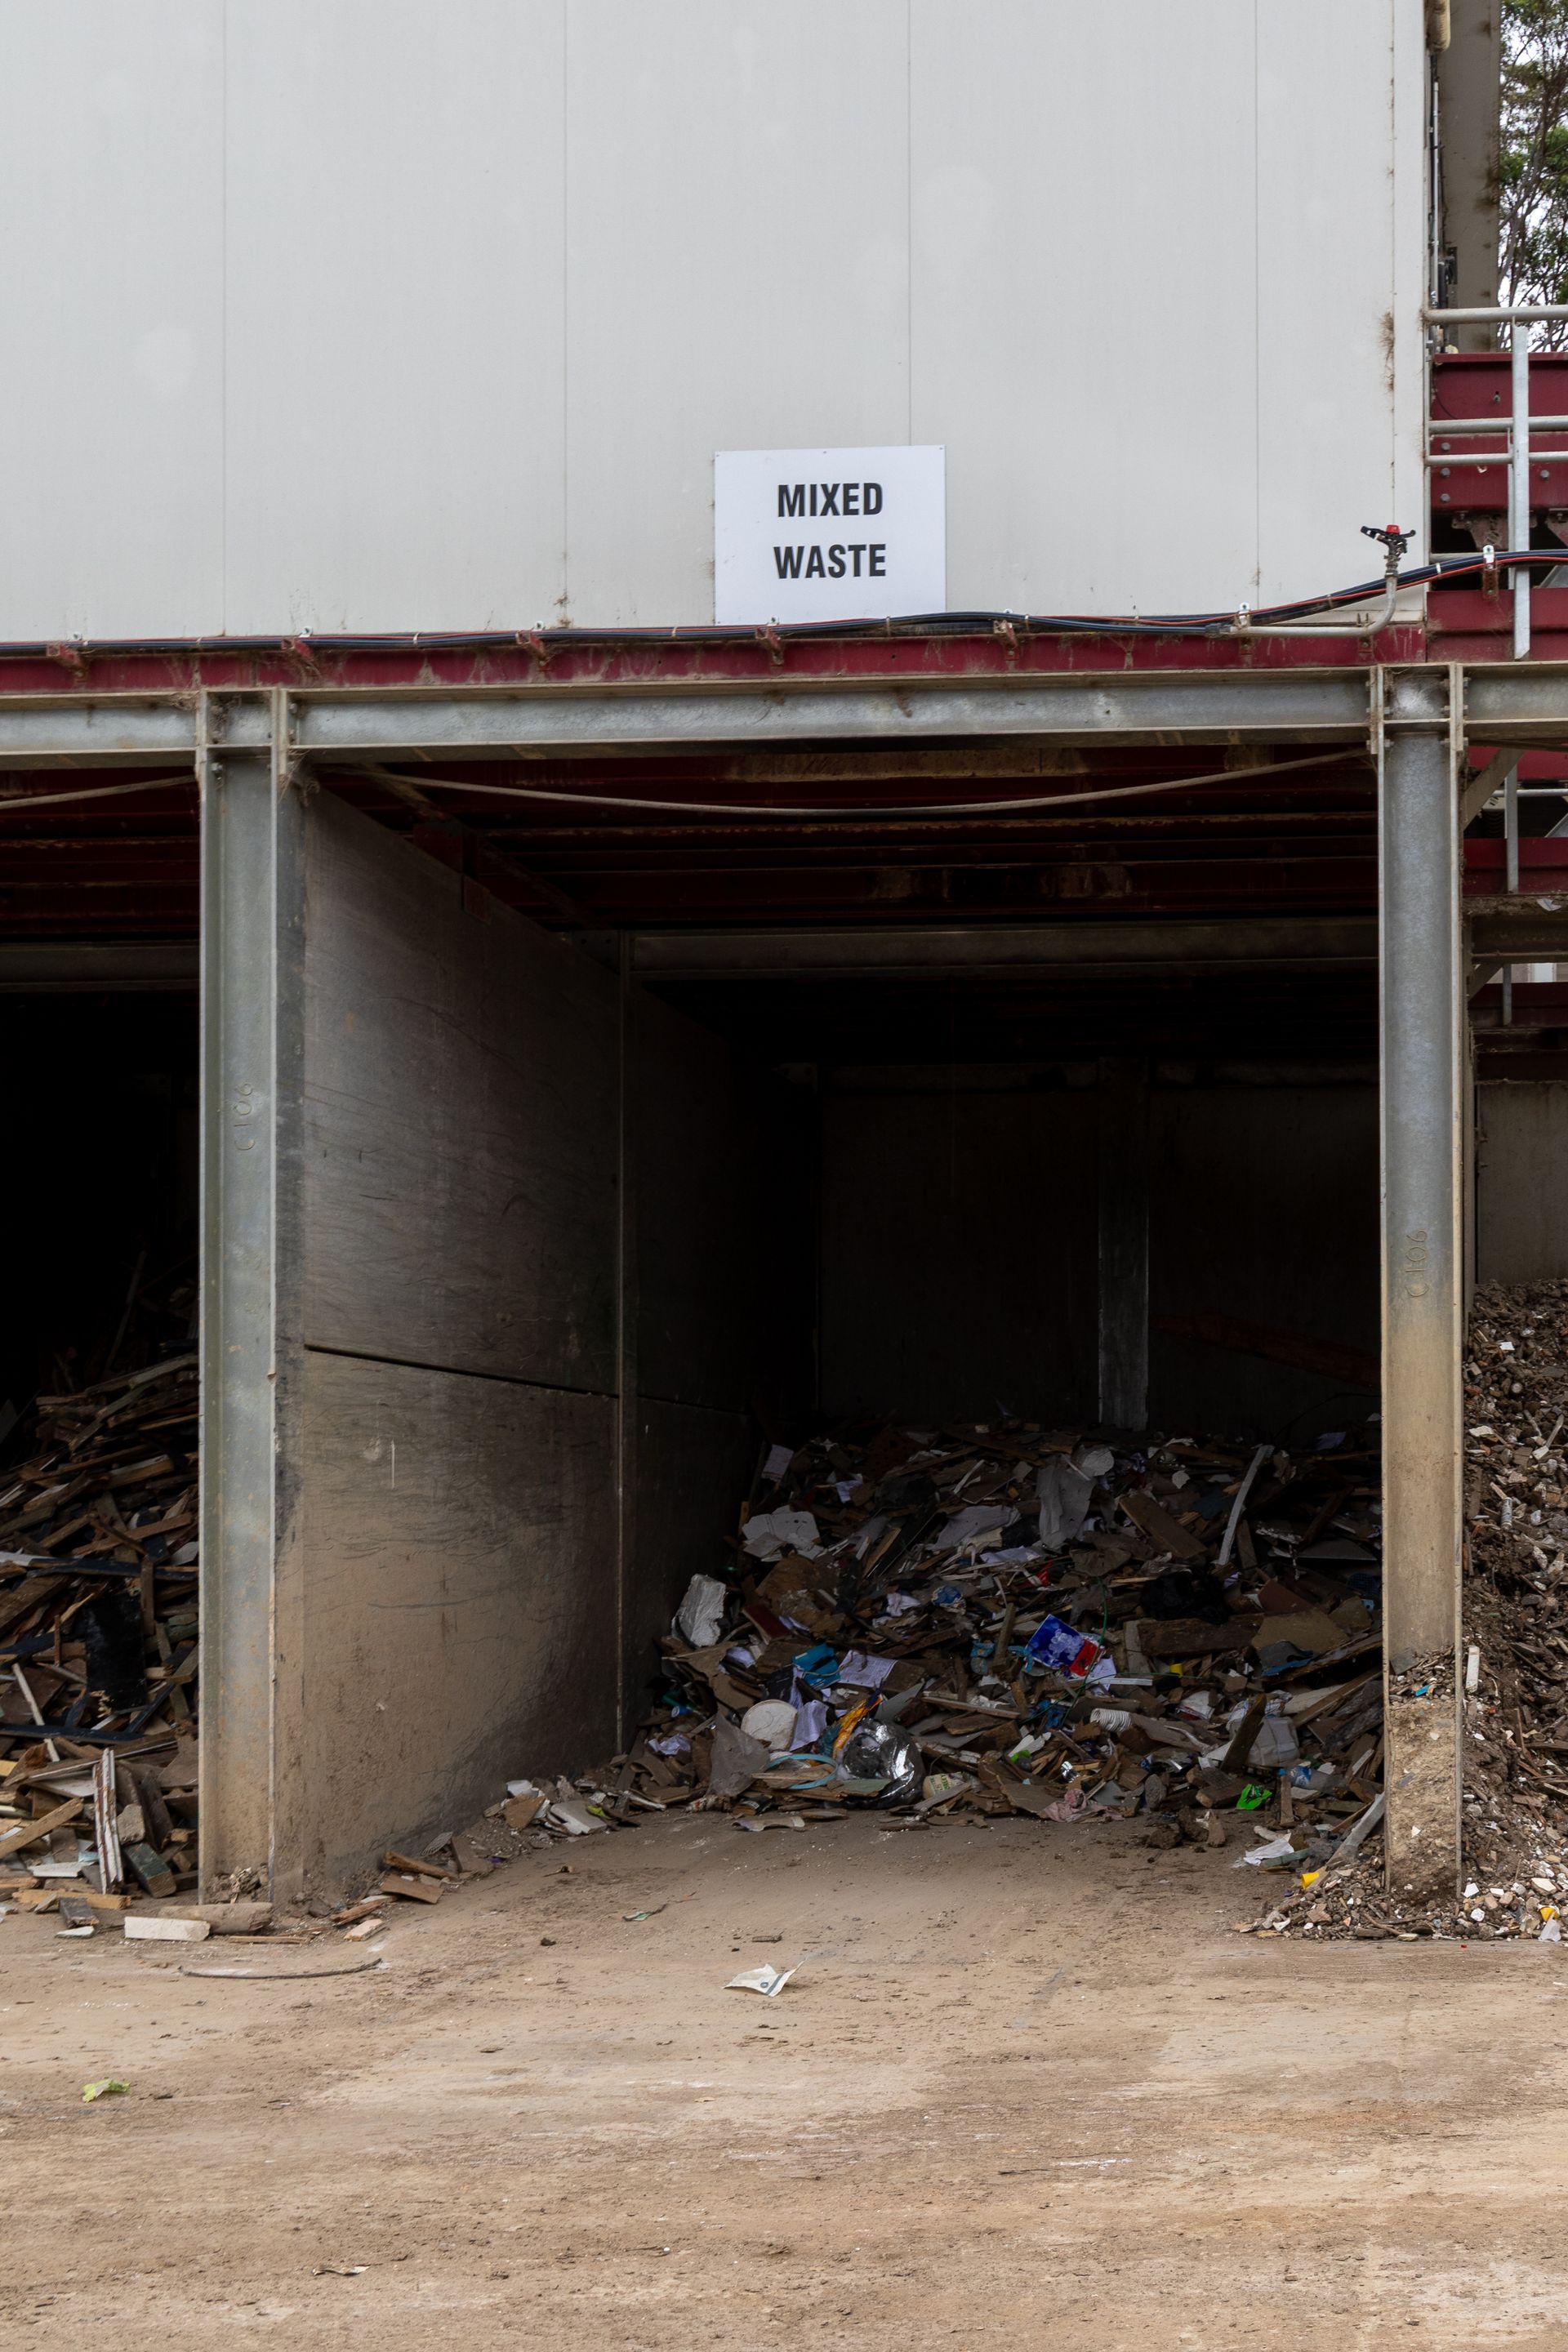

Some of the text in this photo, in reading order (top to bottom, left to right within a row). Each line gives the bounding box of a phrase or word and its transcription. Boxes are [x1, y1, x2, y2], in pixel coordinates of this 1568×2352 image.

[777, 483, 883, 517] MIXED
[773, 544, 886, 578] WASTE
[1405, 1229, 1429, 1298] C106
